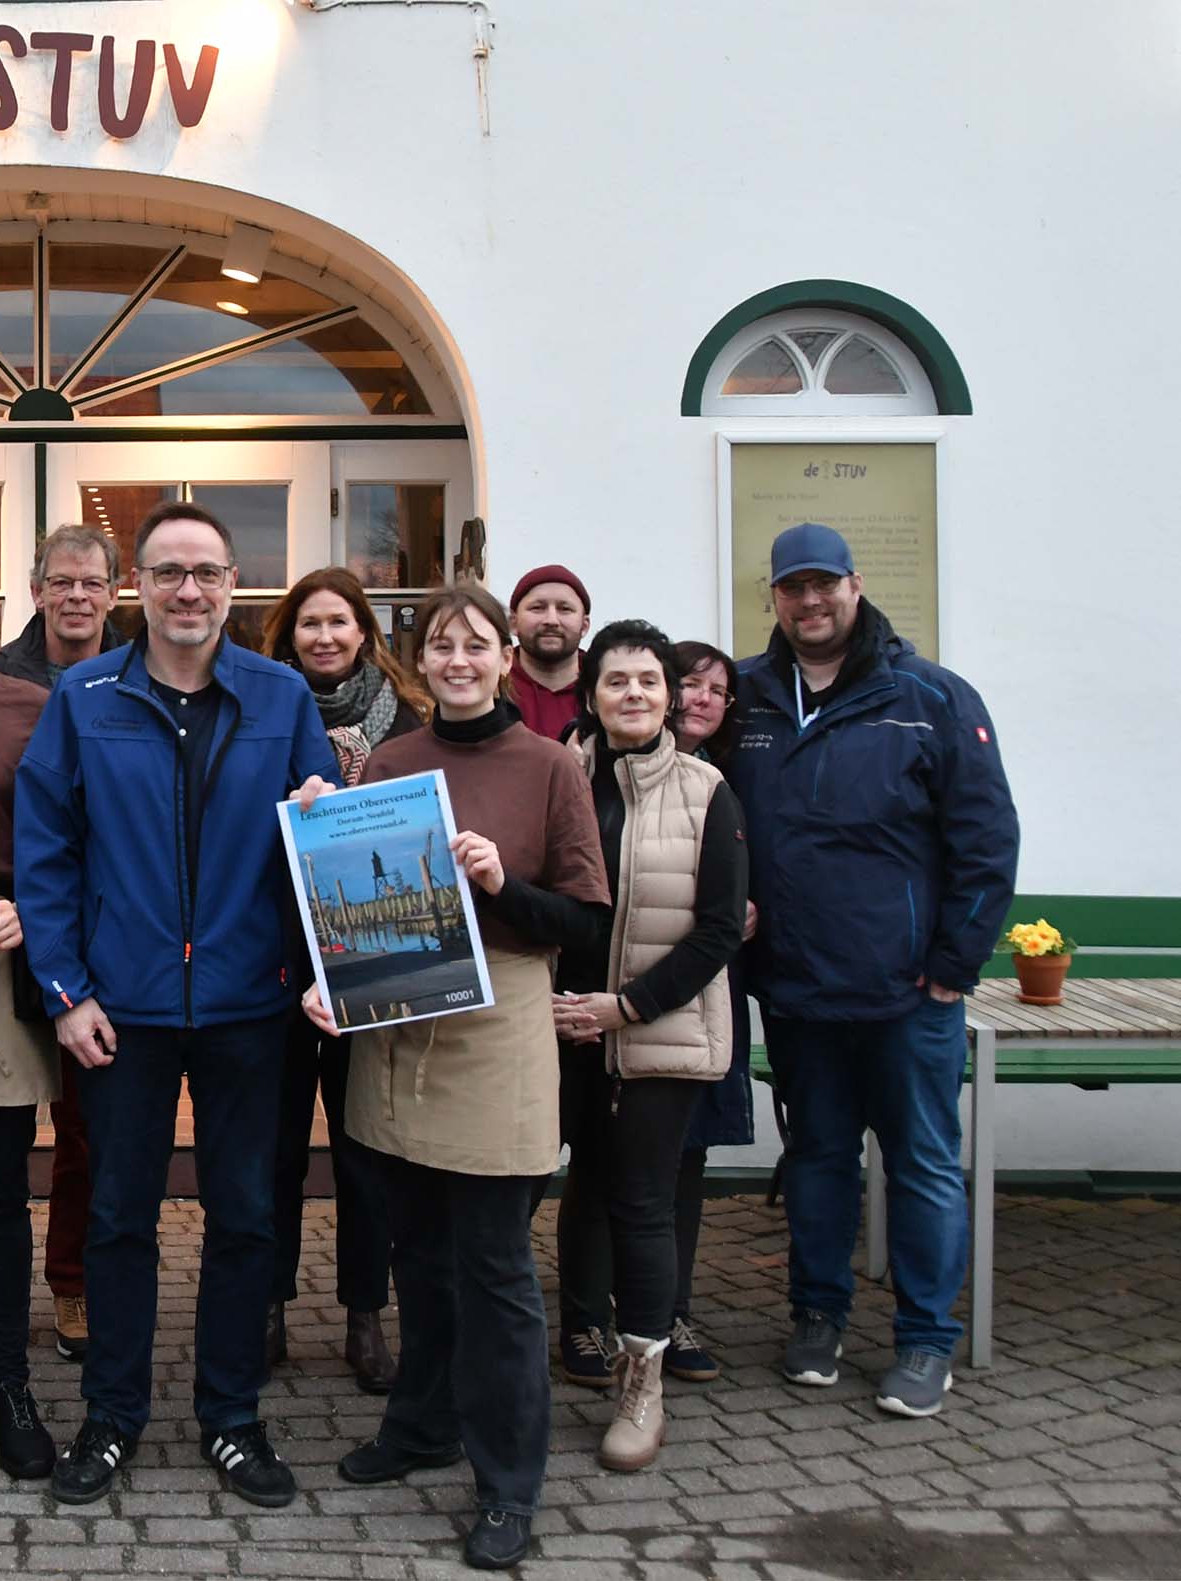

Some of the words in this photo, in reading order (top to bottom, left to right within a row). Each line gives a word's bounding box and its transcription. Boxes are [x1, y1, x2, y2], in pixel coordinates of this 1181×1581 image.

[803, 462, 820, 478] de
[834, 463, 867, 479] STUV
[300, 805, 358, 821] Leuchtturm
[359, 788, 428, 809] Obereversand
[444, 988, 475, 1004] 10001
